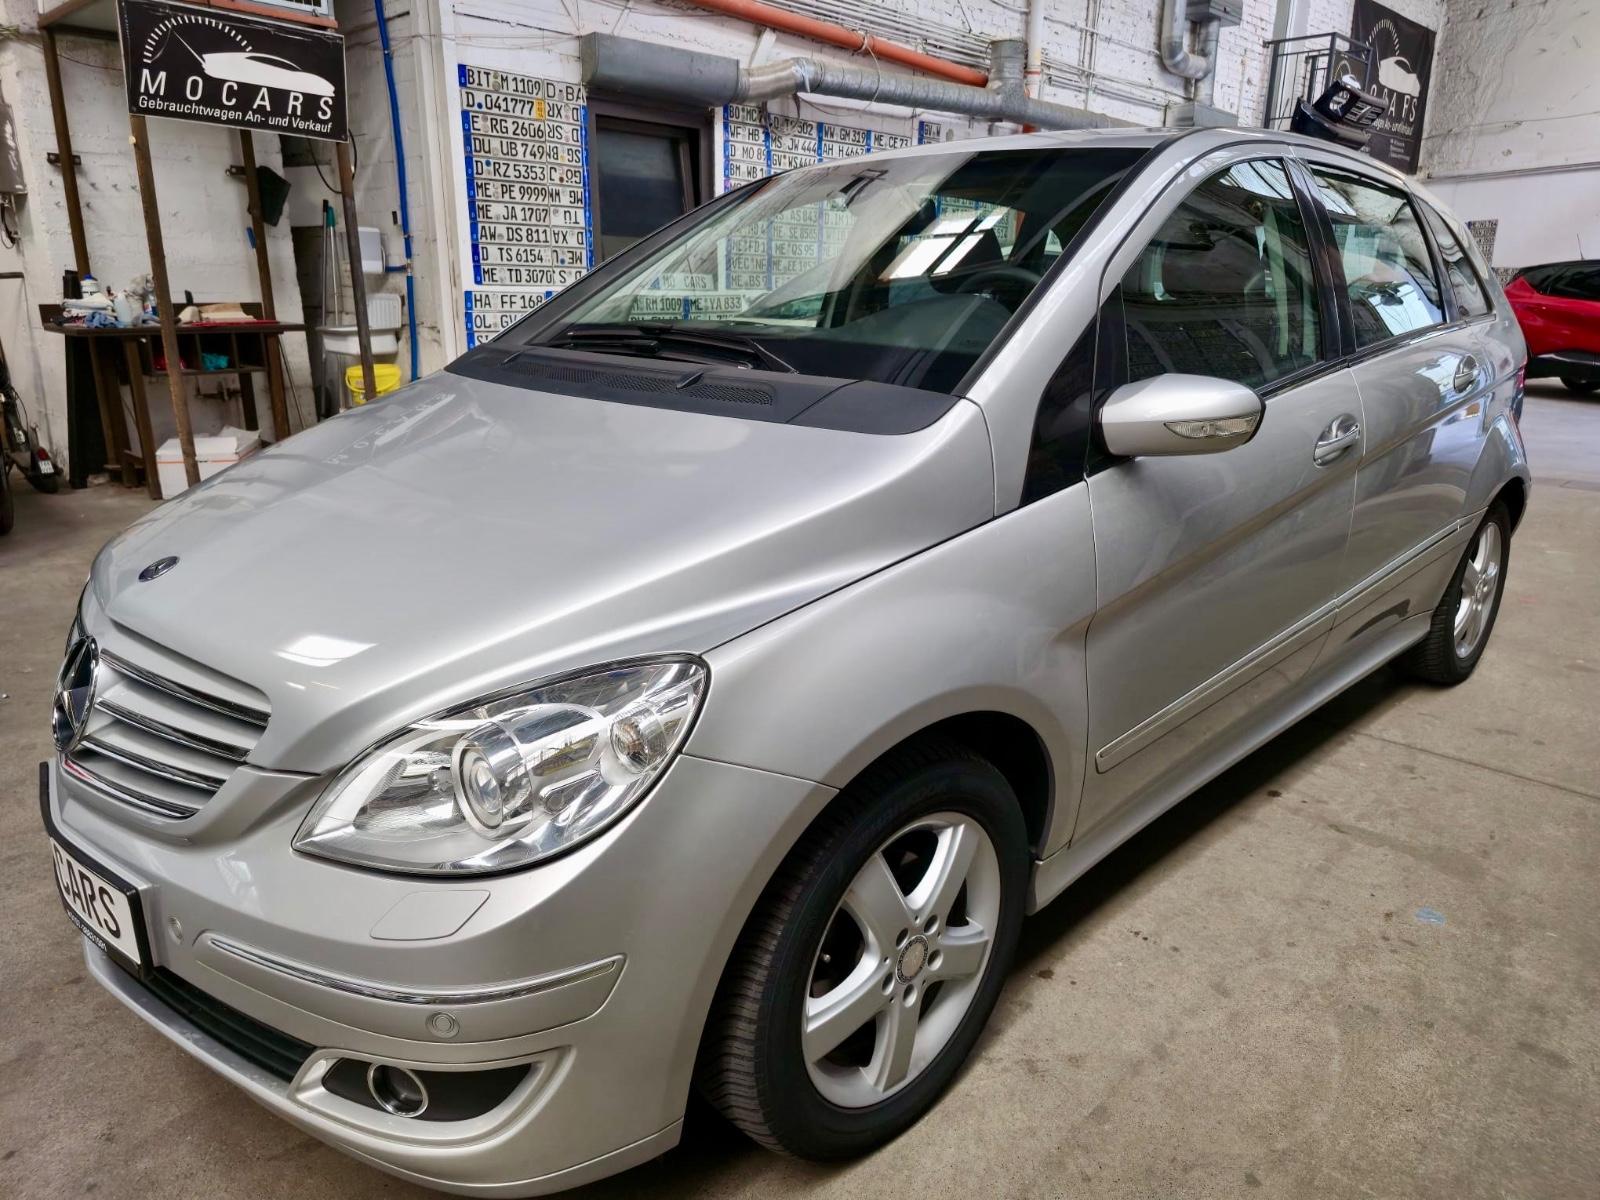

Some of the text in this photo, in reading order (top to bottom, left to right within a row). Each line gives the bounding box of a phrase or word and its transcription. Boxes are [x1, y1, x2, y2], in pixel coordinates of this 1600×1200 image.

[467, 68, 491, 88] BIT
[512, 77, 541, 96] 1109
[466, 91, 475, 107] D
[139, 95, 333, 133] Gebrauchtwagen An- und Verkauf
[471, 115, 544, 139] E RG 2606
[473, 137, 545, 160] DU UB 749
[475, 160, 546, 181] D RZ 5353
[476, 182, 548, 202] ME PE 9999
[477, 204, 549, 223] ME JA 1707
[480, 225, 550, 243] AW DS 811
[481, 246, 543, 263] D TS 6154
[482, 268, 498, 282] ME
[474, 294, 491, 308] HA
[501, 295, 517, 309] FF
[474, 315, 491, 329] OL
[53, 843, 121, 939] CARS
